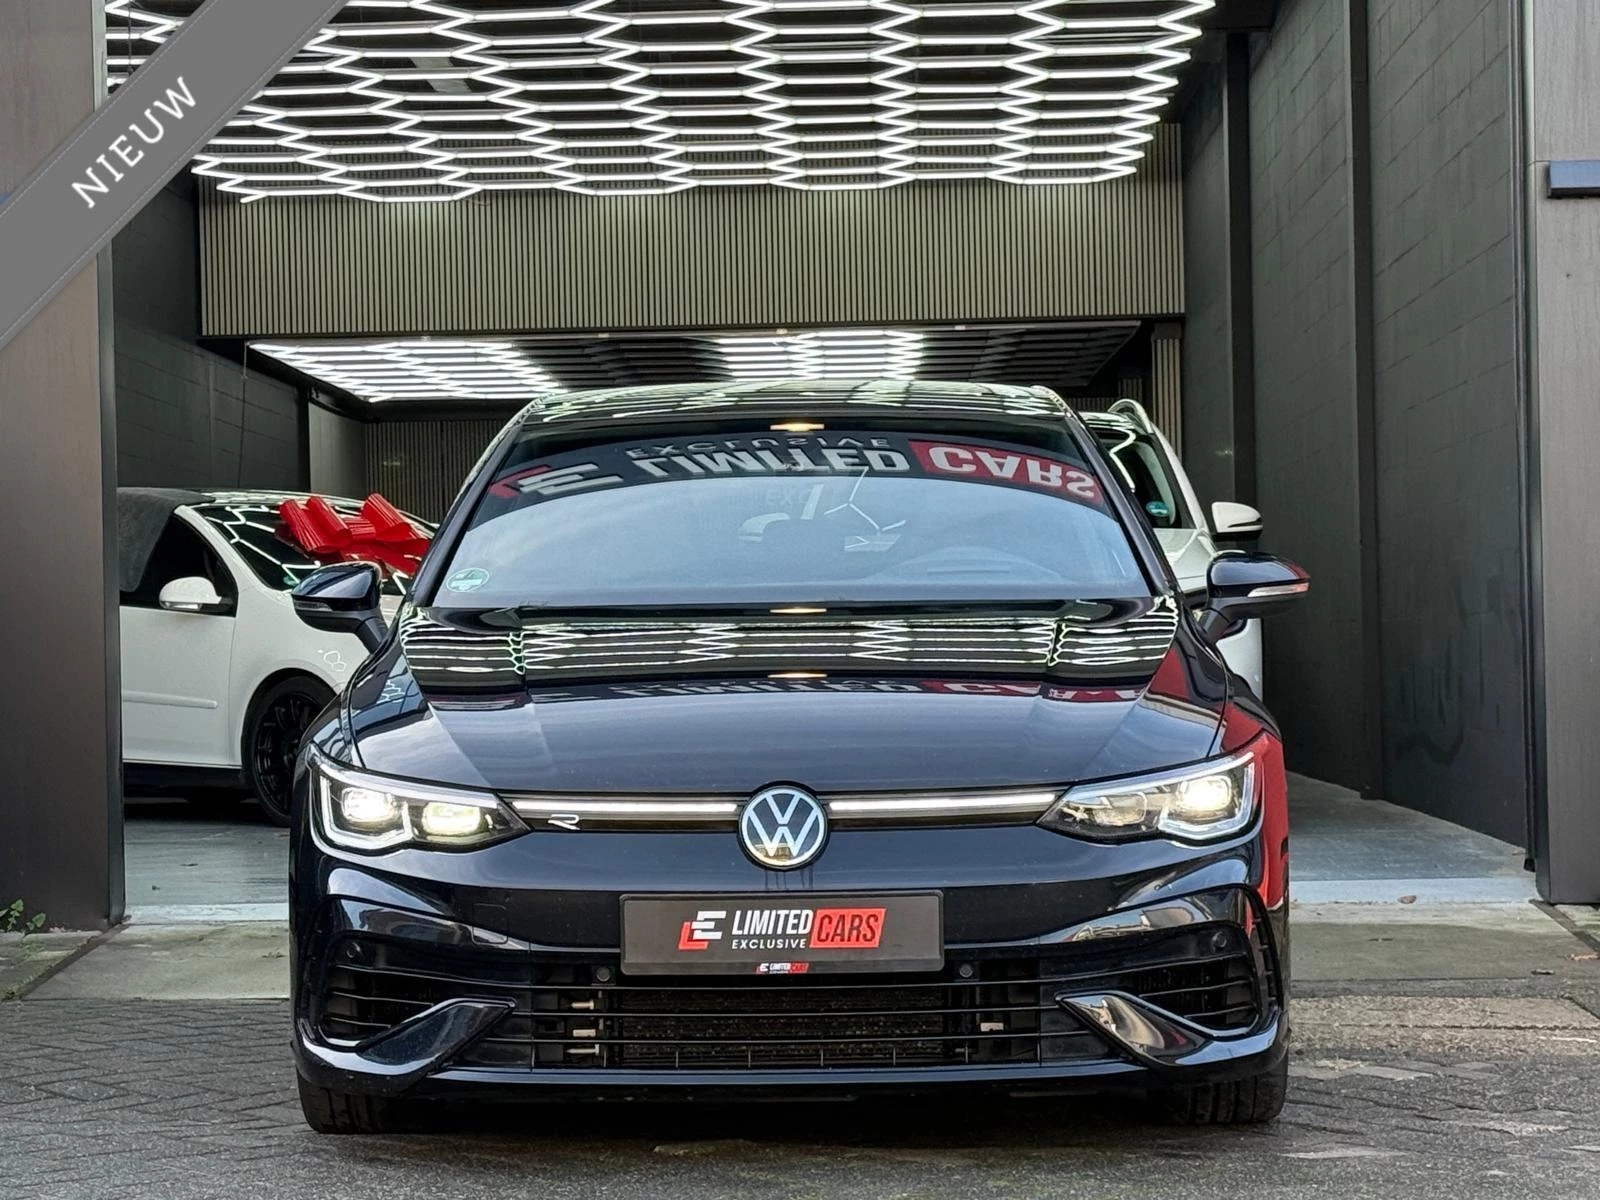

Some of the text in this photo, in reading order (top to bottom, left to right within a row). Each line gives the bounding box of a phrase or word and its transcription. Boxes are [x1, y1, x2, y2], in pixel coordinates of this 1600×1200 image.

[731, 909, 879, 942] LIMITED CARS
[731, 938, 807, 950] EXCLUSIVE
